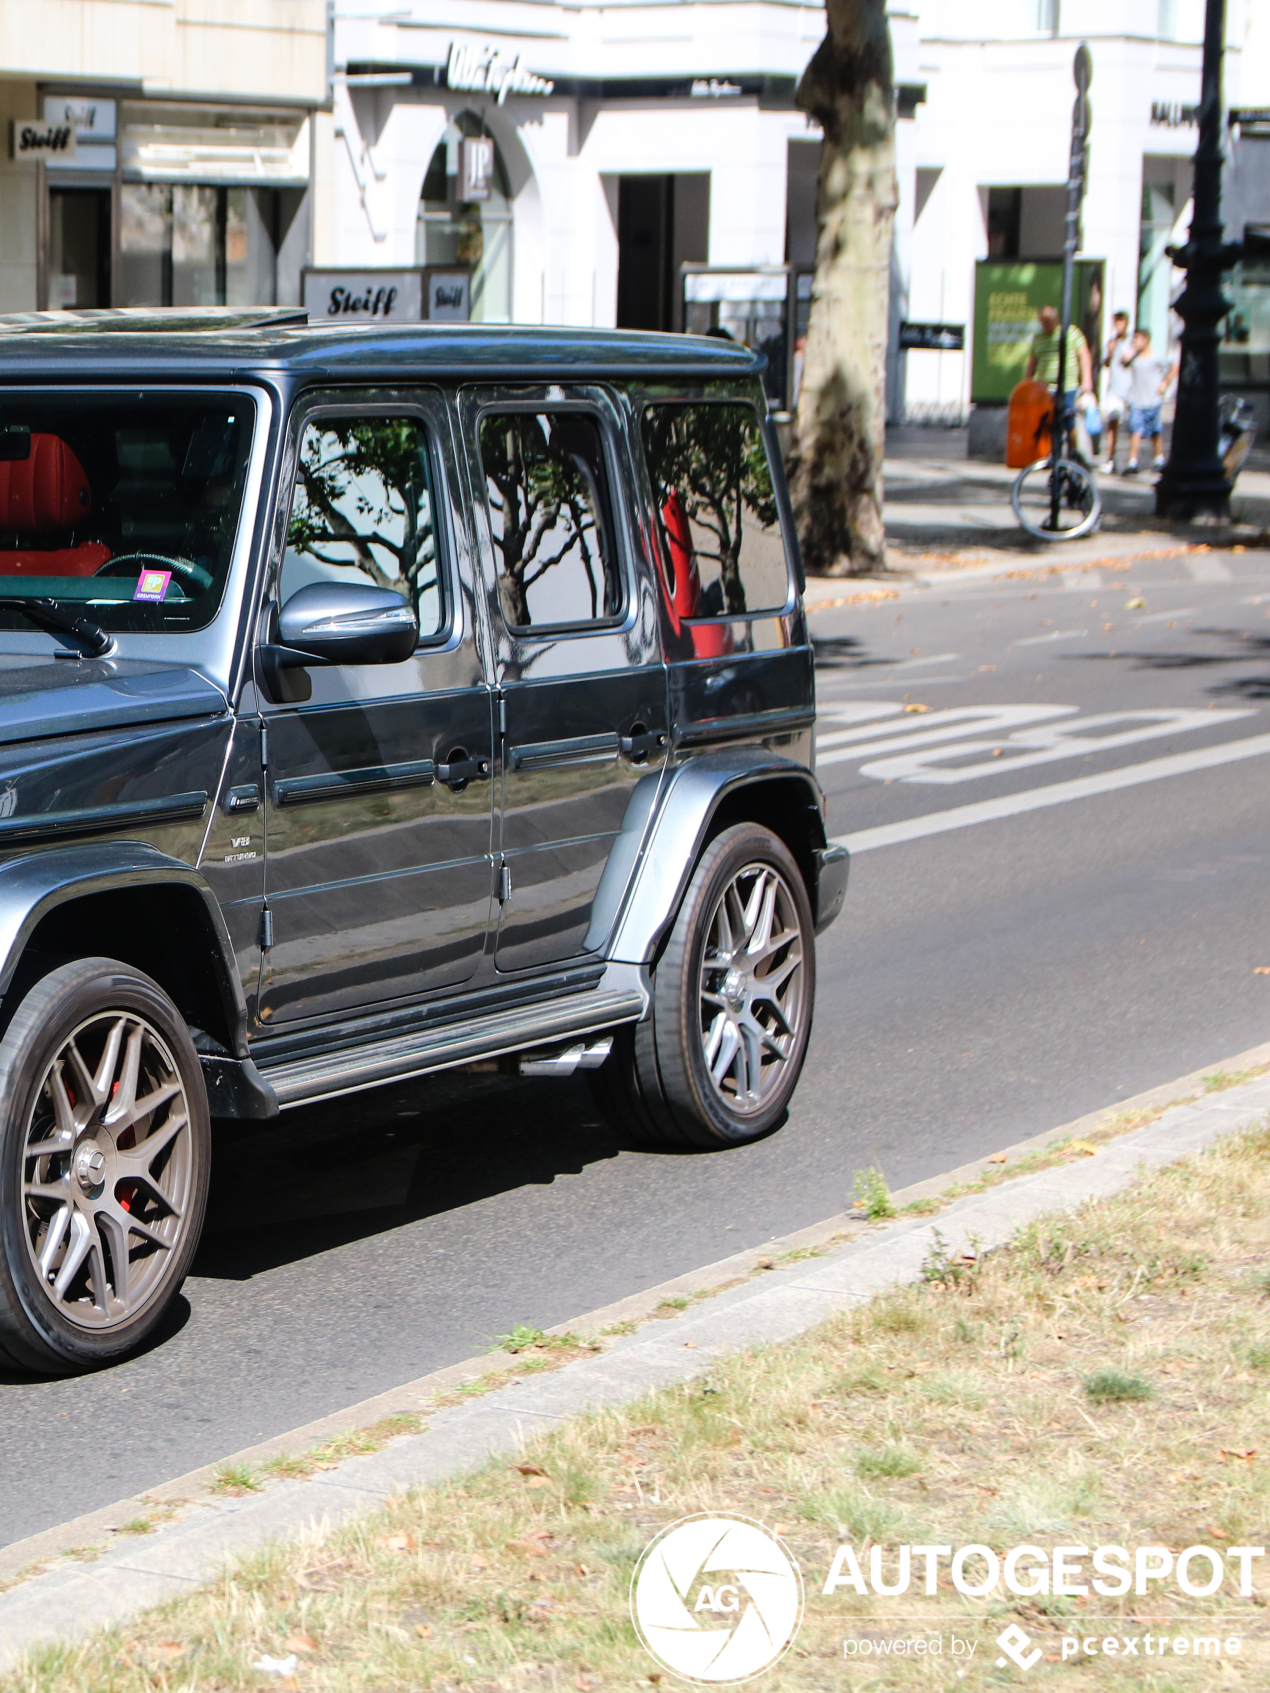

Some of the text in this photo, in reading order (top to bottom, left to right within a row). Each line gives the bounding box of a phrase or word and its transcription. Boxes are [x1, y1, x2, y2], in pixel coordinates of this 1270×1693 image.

[19, 126, 71, 151] Steiff
[328, 285, 398, 316] Steiff
[230, 836, 251, 848] V8
